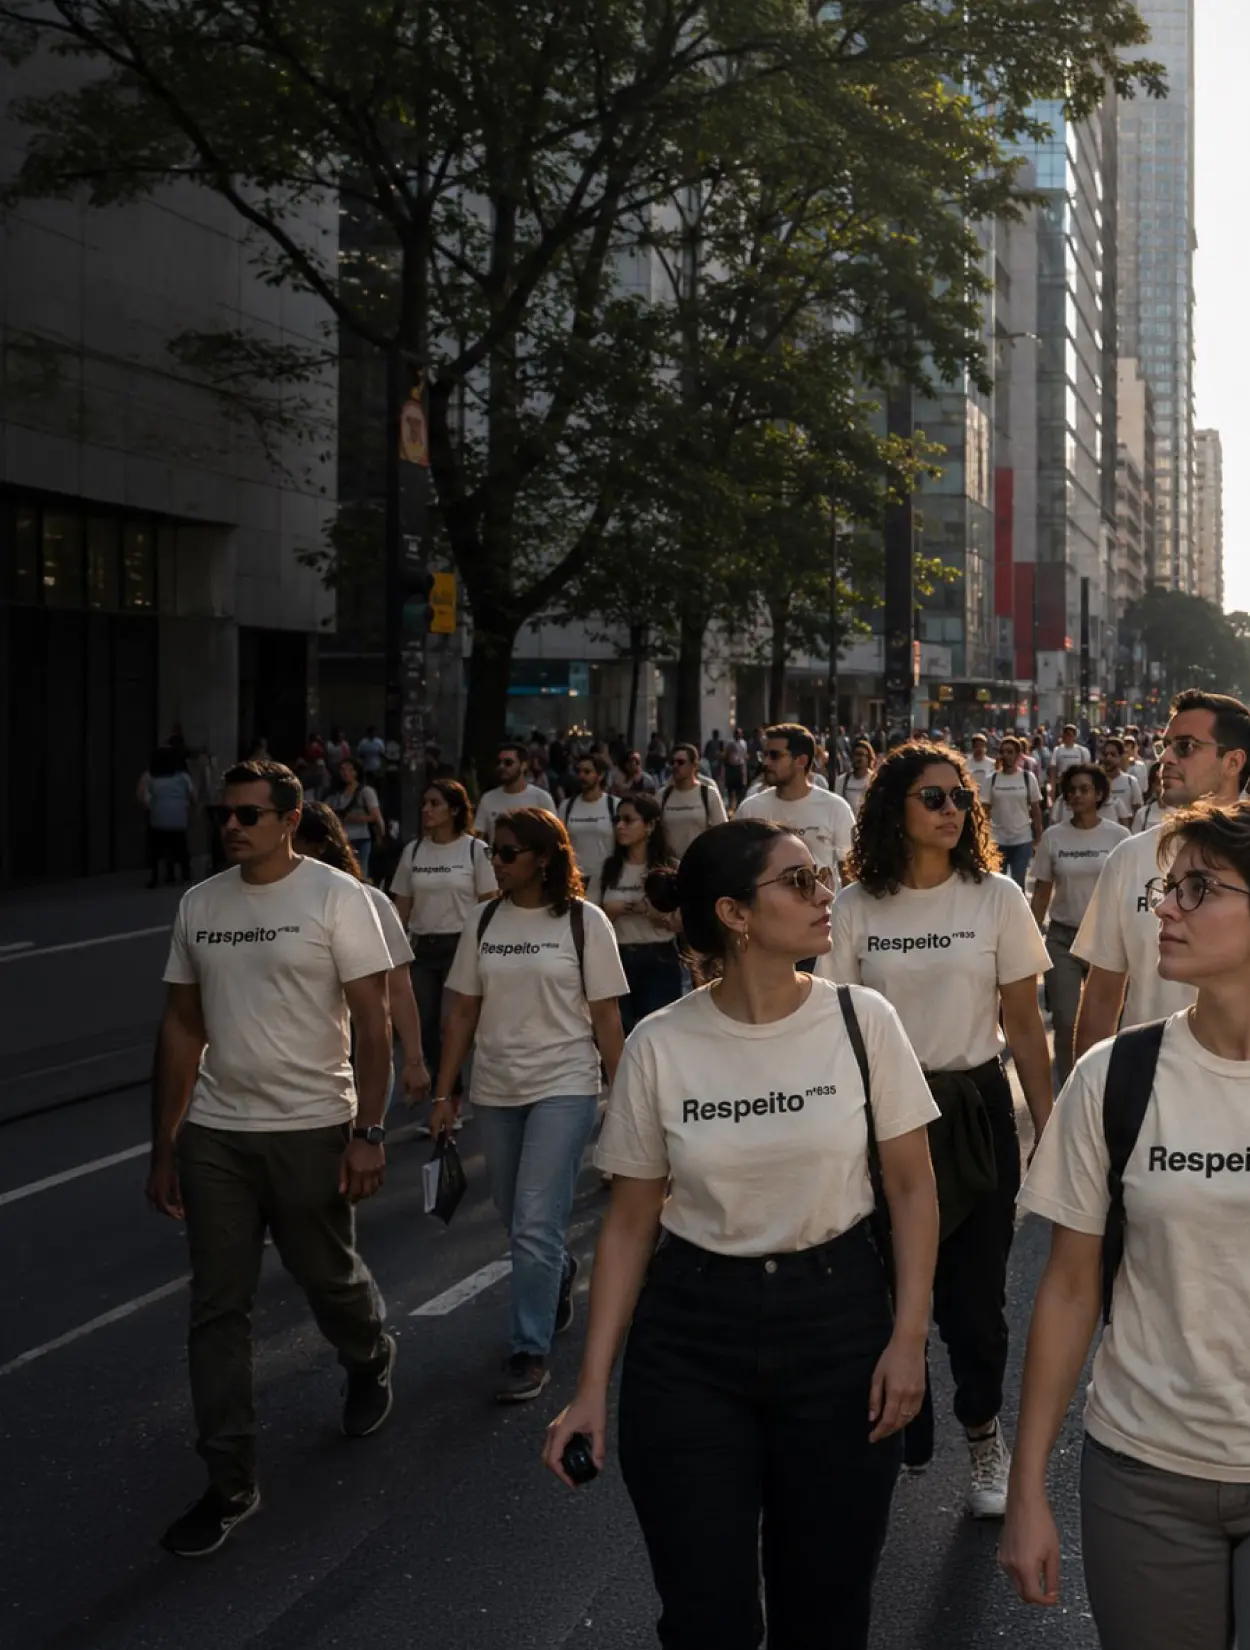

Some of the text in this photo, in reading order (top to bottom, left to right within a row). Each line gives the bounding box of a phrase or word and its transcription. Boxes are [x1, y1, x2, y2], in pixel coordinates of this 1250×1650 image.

[480, 942, 540, 956] Respeito
[867, 933, 951, 953] Respeito
[682, 1091, 805, 1123] Respeito
